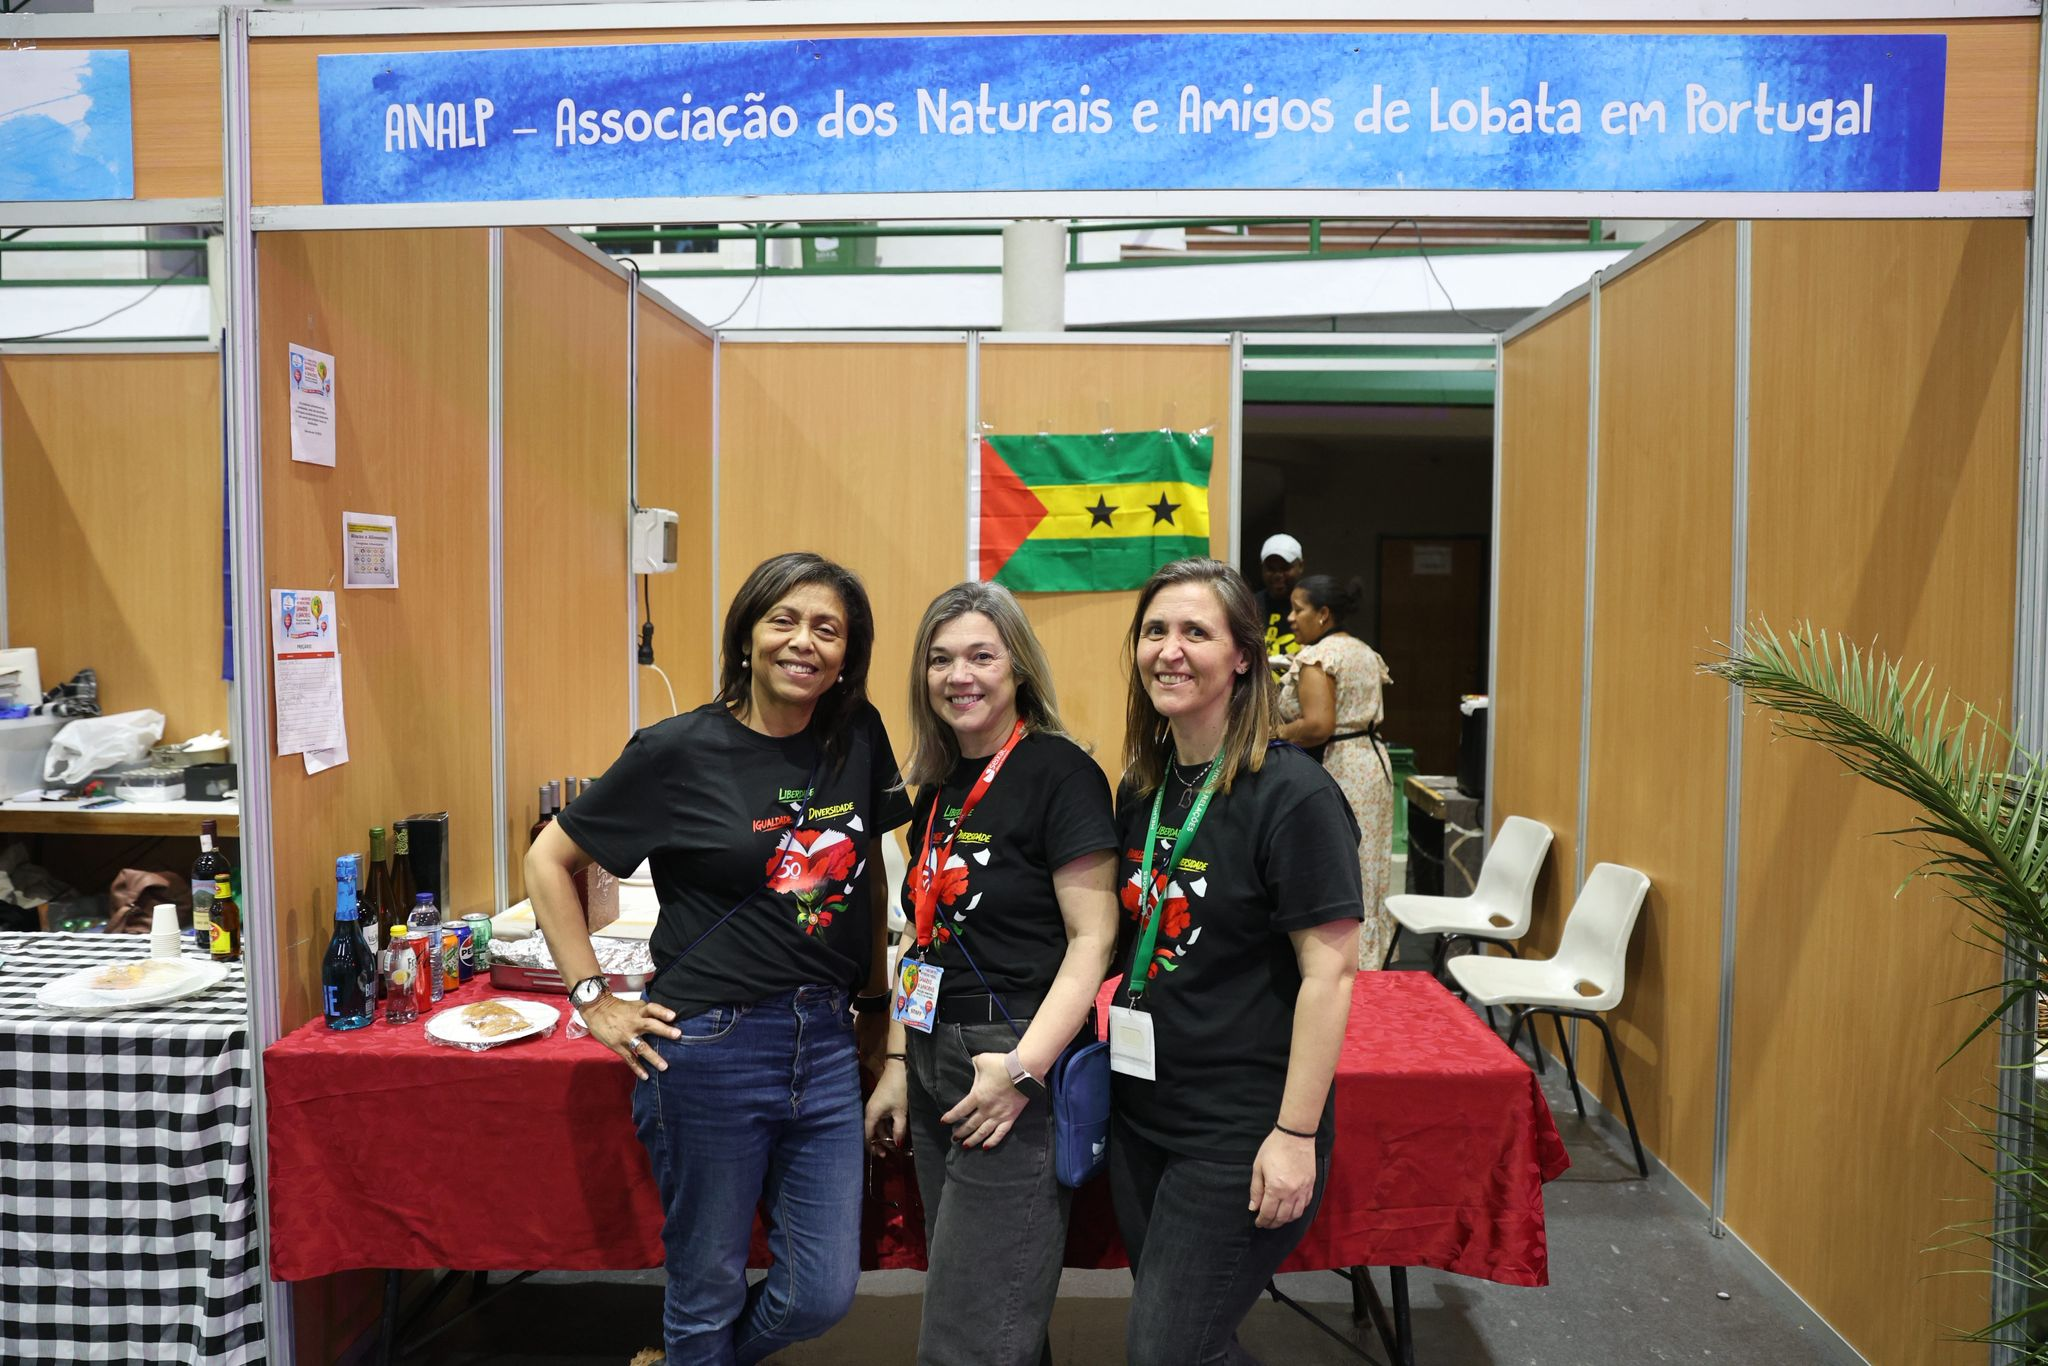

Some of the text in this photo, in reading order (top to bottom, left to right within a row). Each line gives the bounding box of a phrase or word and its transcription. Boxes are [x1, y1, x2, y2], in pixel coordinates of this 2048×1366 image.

[384, 98, 493, 152] ANALP
[556, 91, 798, 148] Associação
[817, 89, 898, 139] dos
[917, 82, 1112, 136] Naturais
[1132, 100, 1159, 133] e
[1178, 83, 1335, 139] Amigos
[1354, 84, 1411, 134] de
[1430, 81, 1581, 136] Lobata
[1600, 100, 1666, 136] em
[1686, 82, 1873, 142] Portugal
[808, 802, 854, 821] DIVERSIDADE
[777, 855, 801, 878] 50
